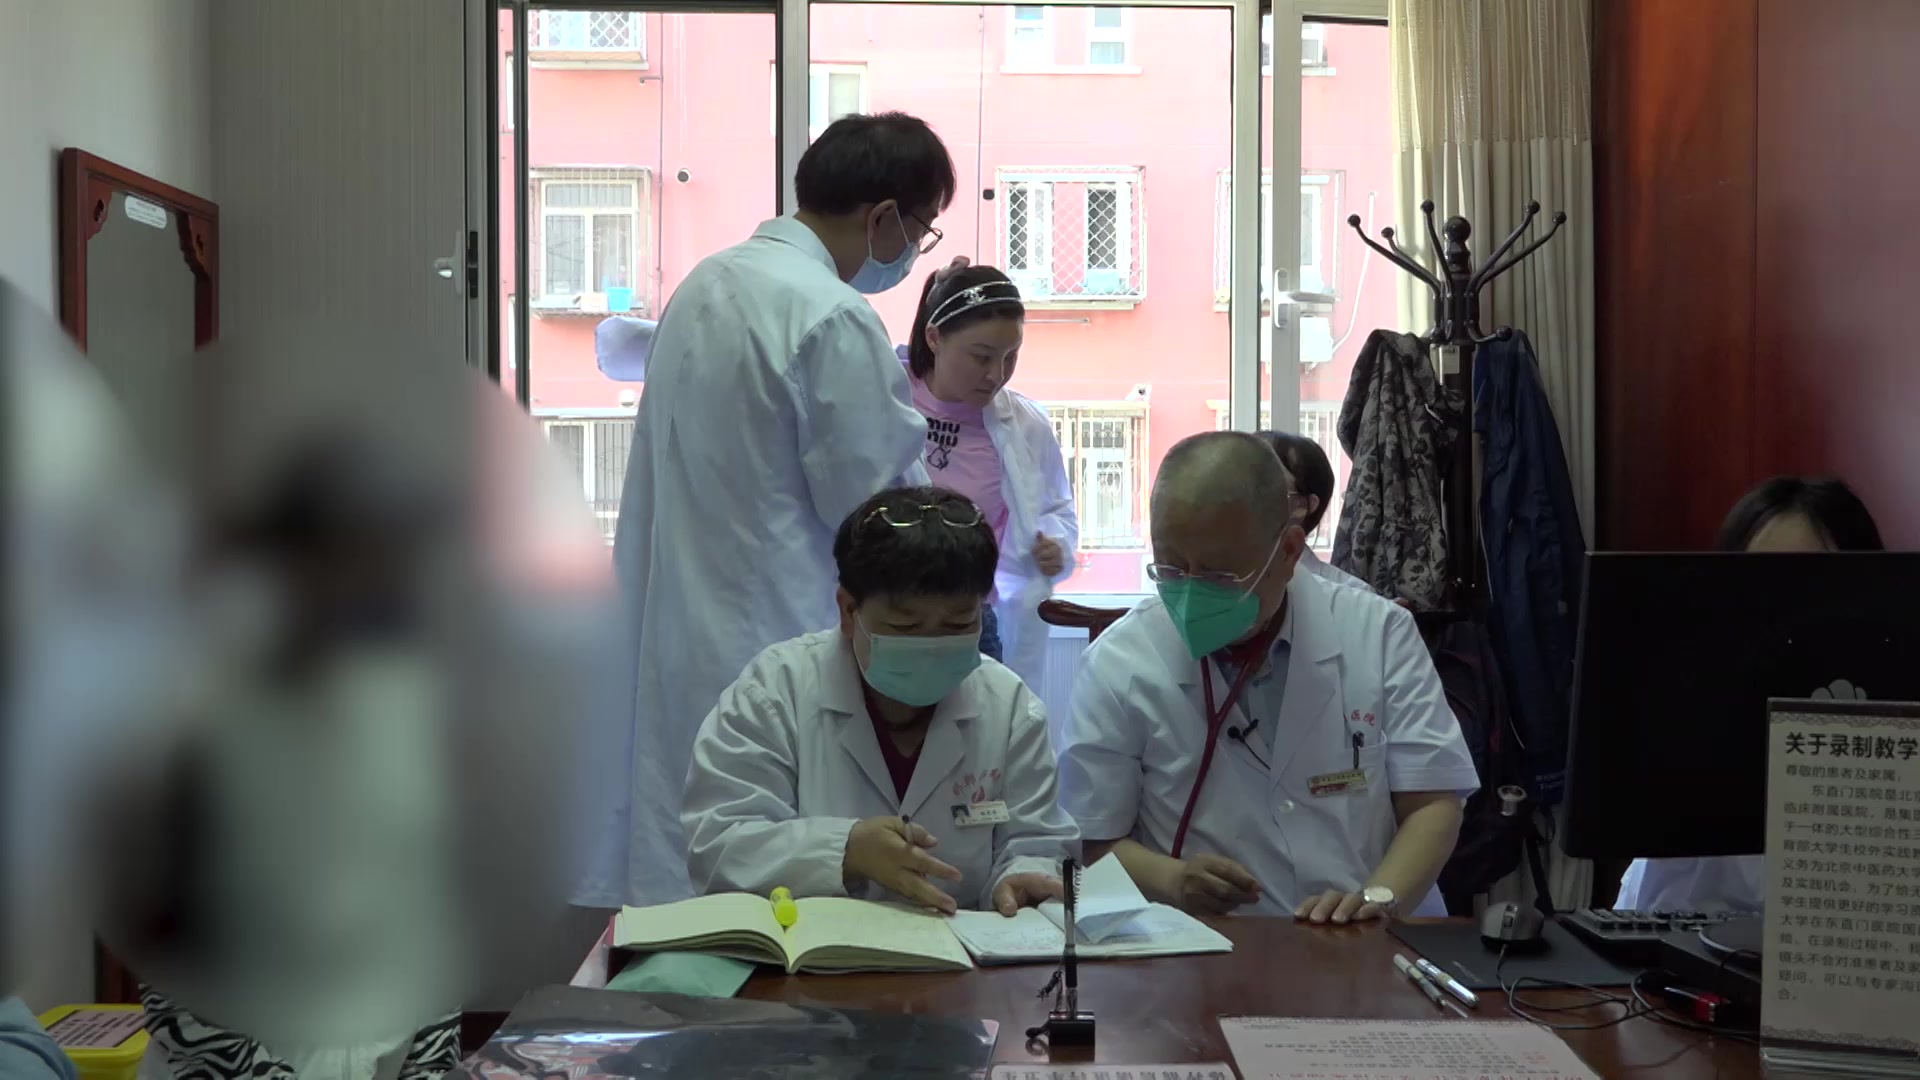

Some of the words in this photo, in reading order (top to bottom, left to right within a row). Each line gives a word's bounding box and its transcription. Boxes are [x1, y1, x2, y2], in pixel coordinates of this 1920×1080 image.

[1785, 731, 1919, 760] 关于录制教学
